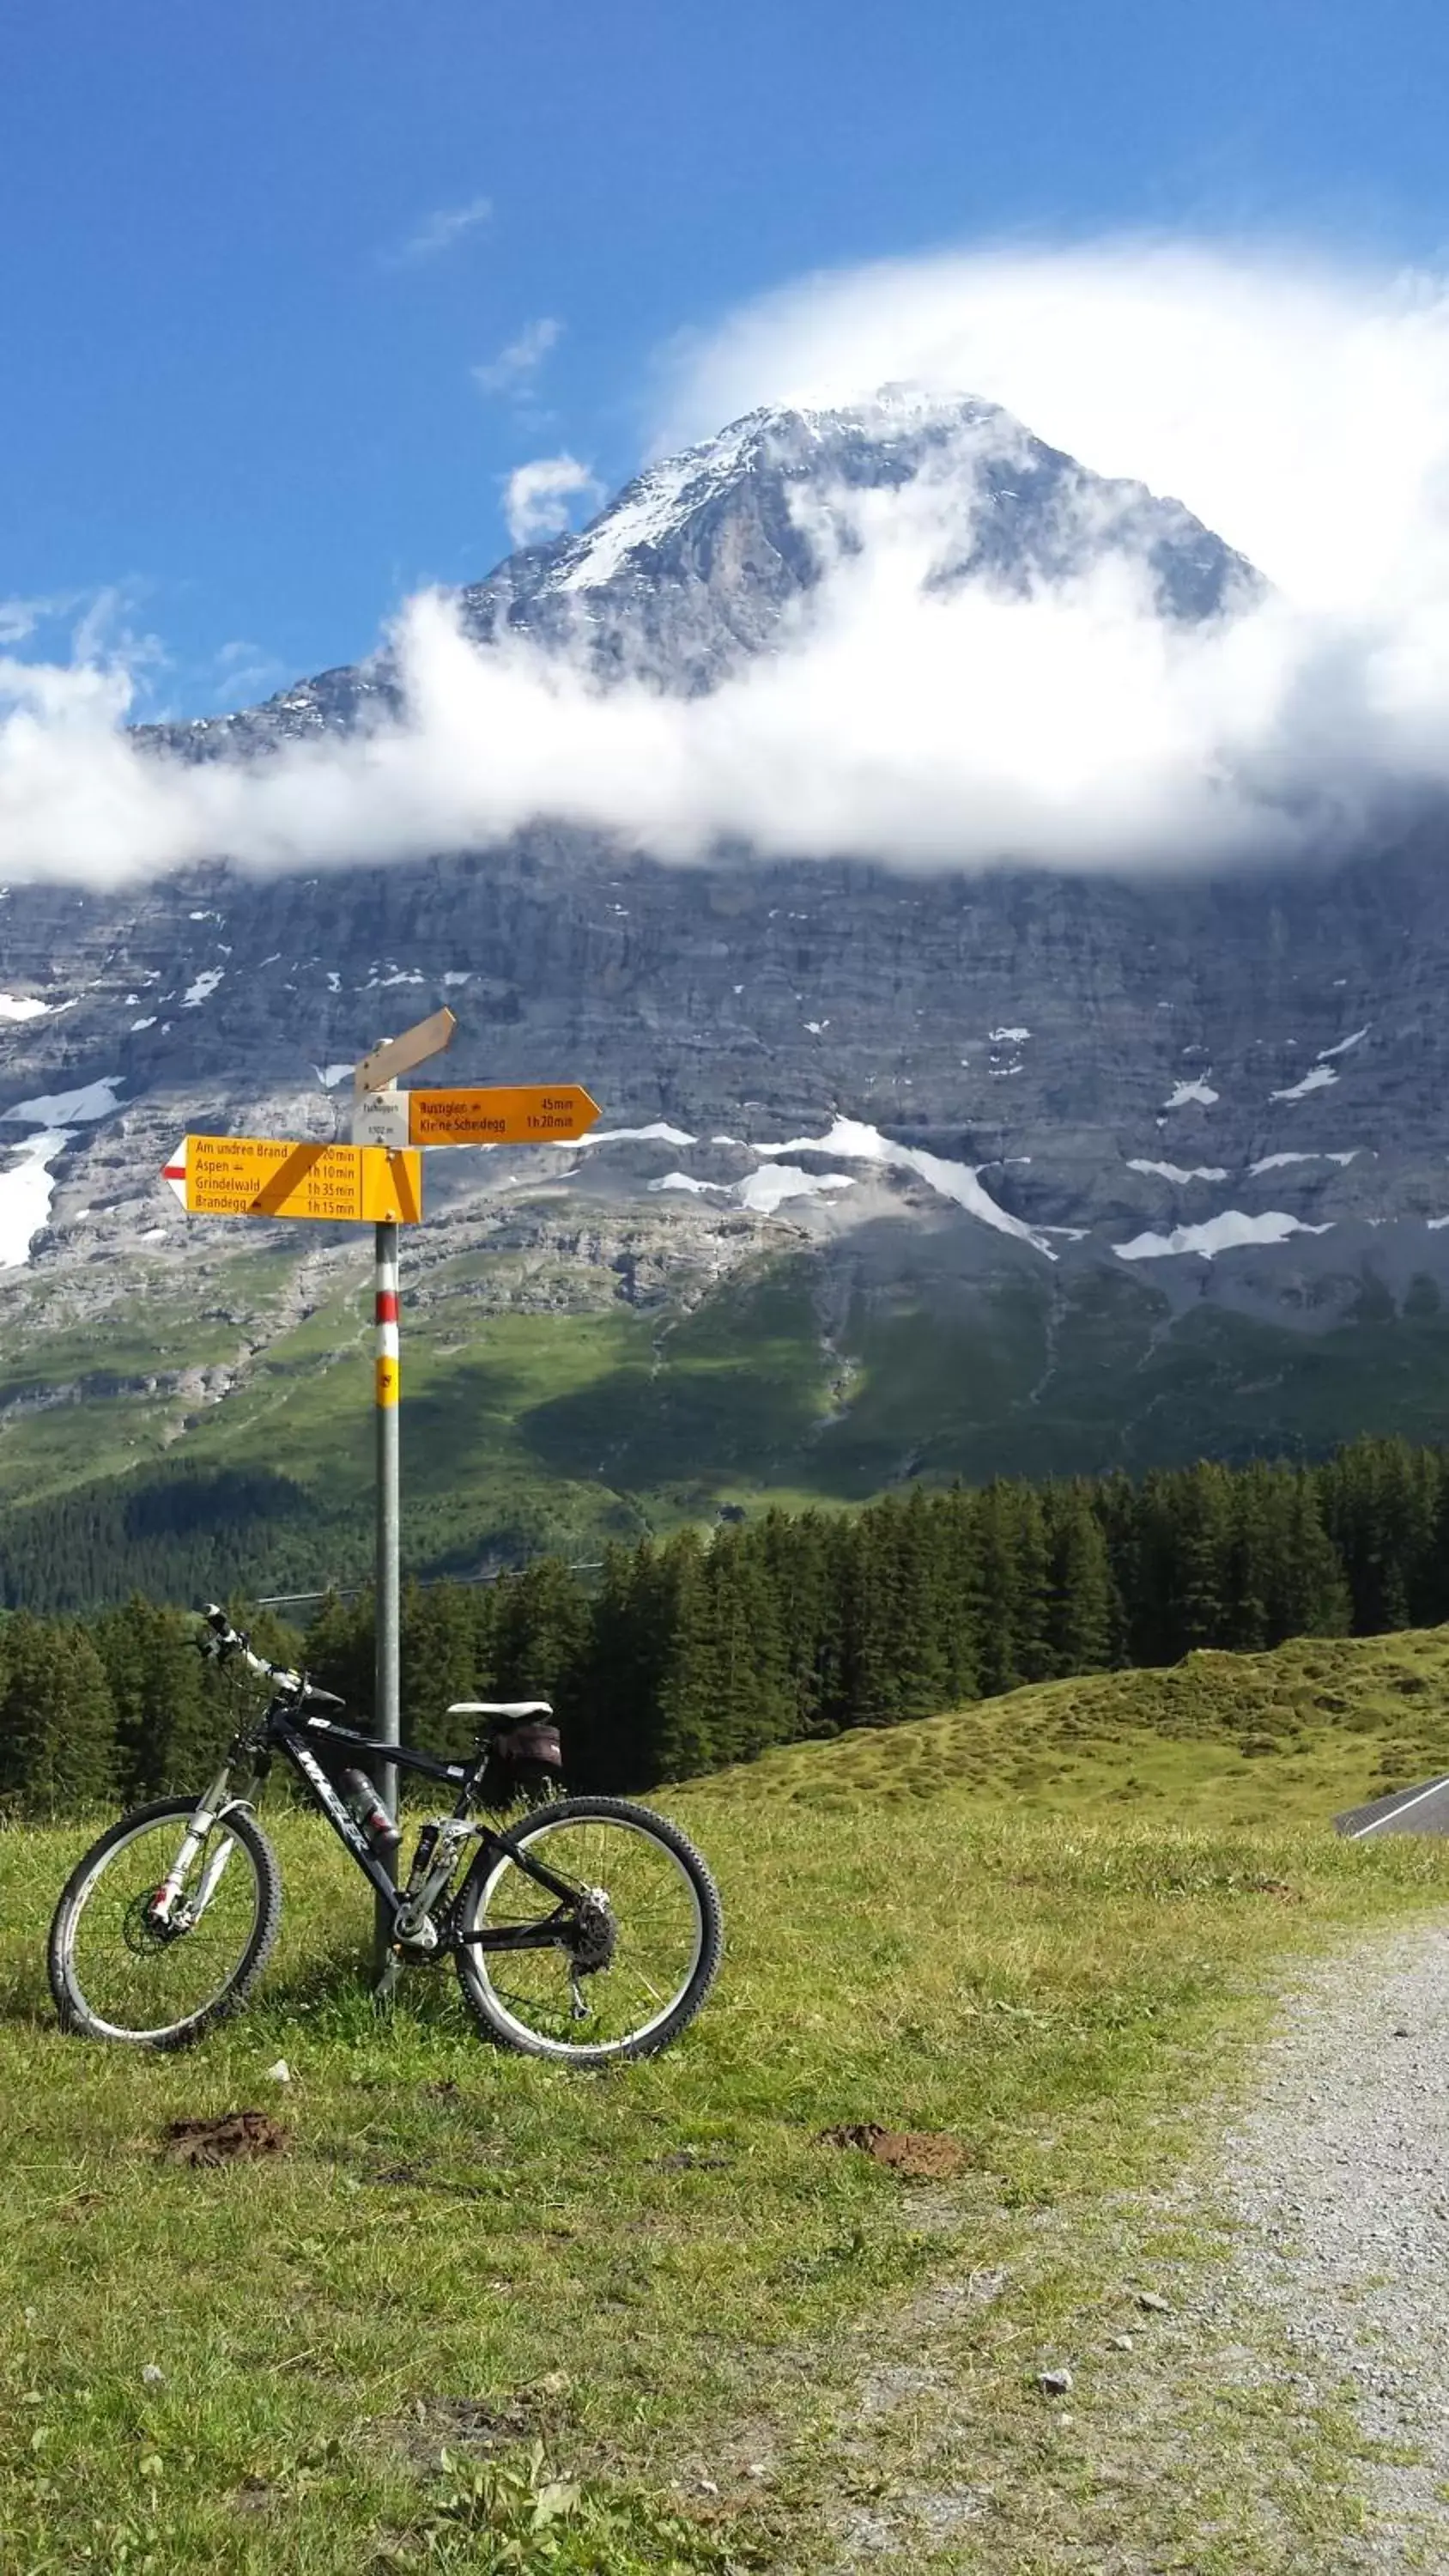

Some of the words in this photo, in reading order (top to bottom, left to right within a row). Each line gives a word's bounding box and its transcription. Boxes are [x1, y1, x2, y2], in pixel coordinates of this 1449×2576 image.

[196, 1139, 214, 1154] Am
[257, 1144, 288, 1158] Brand
[196, 1158, 229, 1174] Aspen
[196, 1176, 260, 1192] Grindelwald
[196, 1194, 247, 1213] Brandegg
